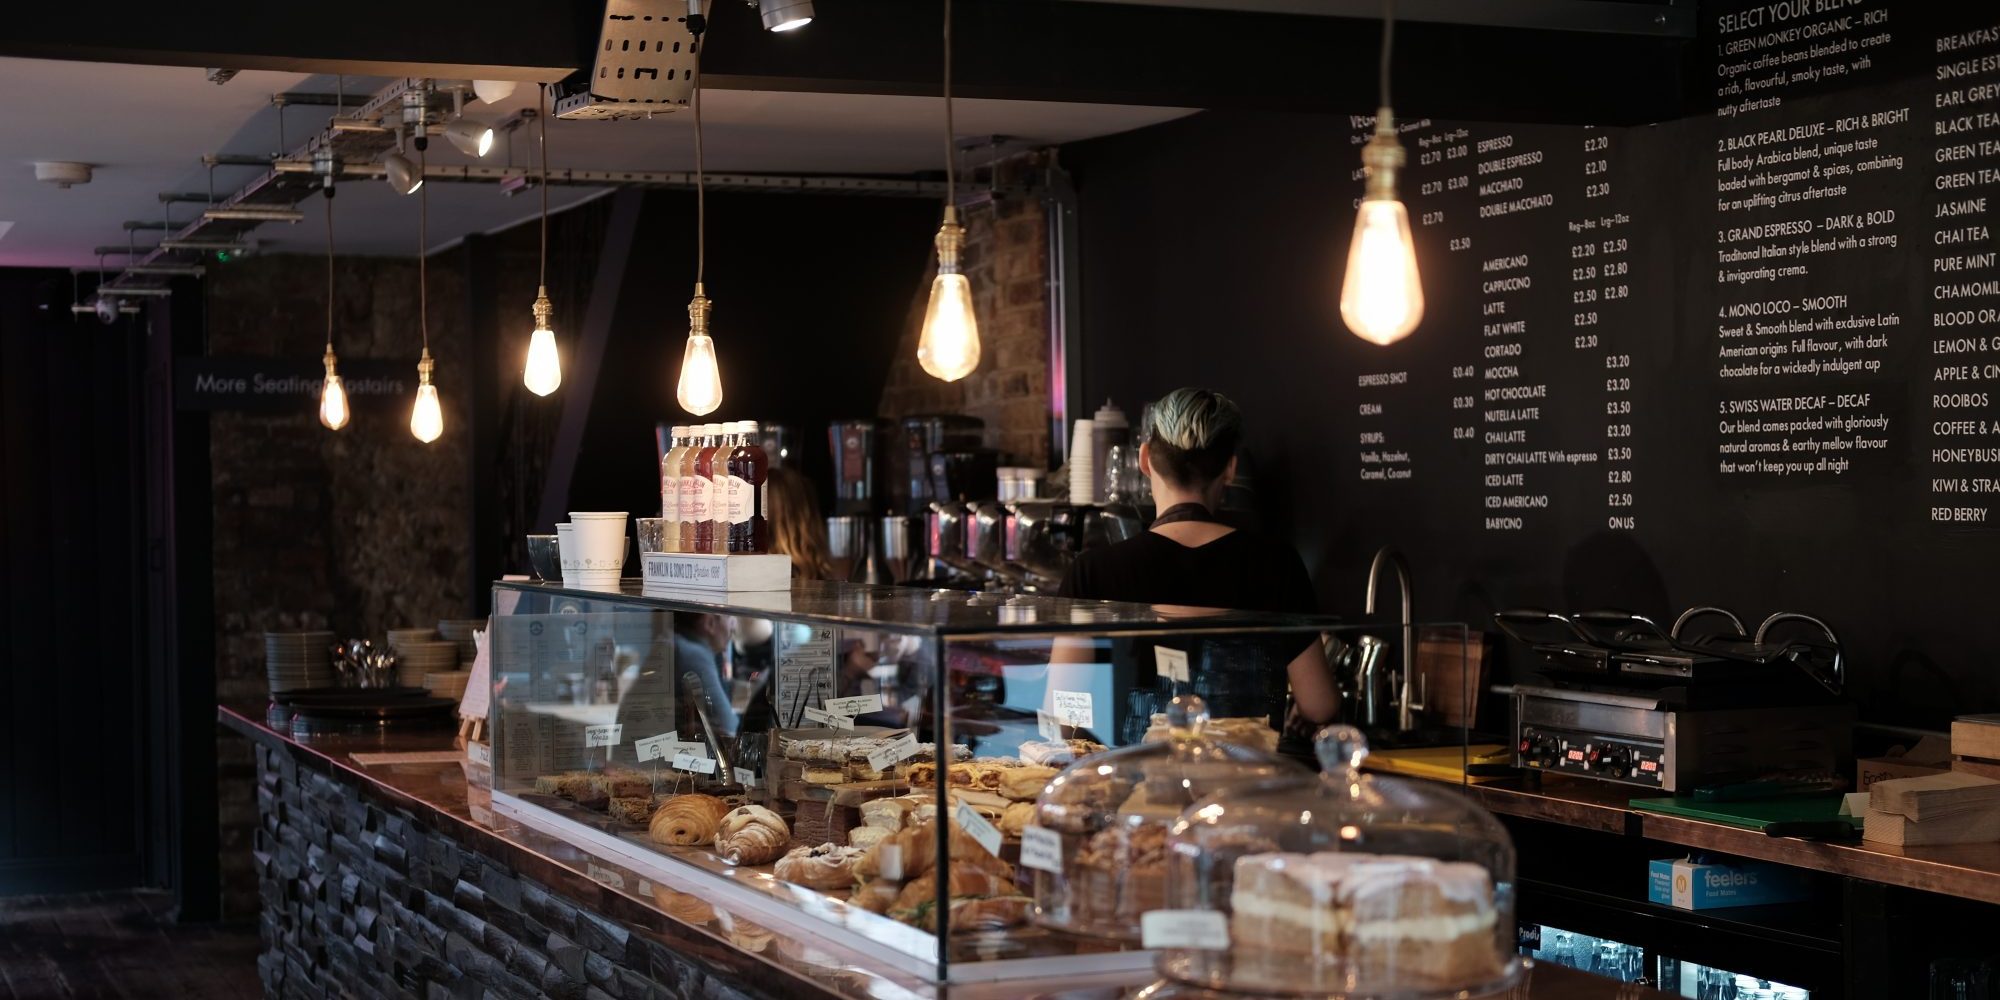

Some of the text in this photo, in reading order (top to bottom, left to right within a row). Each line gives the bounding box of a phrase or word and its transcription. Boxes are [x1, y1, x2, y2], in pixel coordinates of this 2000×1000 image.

[1719, 7, 1765, 34] SELECT
[1769, 0, 1810, 23] YOUR
[1718, 9, 1888, 56] 1. GREEN MONKEY ORGANIC RICH
[1937, 26, 2000, 53] BREAKFAS
[1937, 59, 1978, 80] SINGLE
[1936, 83, 2000, 108] EARL GREY
[1718, 108, 1909, 152] 2. BLACK PEARL DELUXE RICH & BRIGHT
[1936, 112, 2000, 135] BLACK TEA
[1477, 135, 1513, 154] ESPRESSO
[1585, 136, 1608, 151] £2.20
[1421, 145, 1468, 165] £2.70 £3.00
[1936, 140, 2000, 163] GREEN TEA
[1478, 151, 1543, 175] DOUBLE ESPRESSO
[1586, 160, 1607, 174] £2.10
[1422, 176, 1469, 195] £2.70 £3.00
[1479, 177, 1523, 196] MACCHIATO
[1936, 169, 2000, 189] GREEN TEA
[1586, 182, 1609, 197] £2.30
[1480, 194, 1553, 218] DOUBLE MACCHIATO
[1936, 198, 1986, 217] JASMINE
[1423, 211, 1443, 225] £2.70
[1718, 210, 1895, 242] 3. GRAND ESPRESSO DARK & BOLD
[1935, 226, 1989, 244] CHAI TEA
[1450, 237, 1471, 251] £3.50
[1572, 238, 1627, 258] £2.20 £2.50
[1719, 235, 1897, 262] Traditional Italian style blend with a strong
[1483, 255, 1528, 272] AMERICANO
[1934, 253, 1997, 272] PURE MINT
[1573, 262, 1627, 280] £2.50 £2.80
[1719, 265, 1808, 284] & invigorating crema.
[1483, 276, 1530, 293] CAPPUCCINO
[1574, 285, 1628, 303] £2.50 £2.80
[1483, 301, 1505, 315] LATTE
[1719, 295, 1848, 318] 4. MONO LOCO SMOOTH
[1575, 312, 1597, 326] £2.50
[1934, 311, 1974, 326] BLOOD
[1484, 321, 1525, 336] FLAT WHITE
[1575, 335, 1597, 348] £2.30
[1934, 337, 1987, 354] LEMON &
[1485, 343, 1521, 358] CORTADO
[1606, 355, 1629, 368] £3.20
[1453, 365, 1474, 378] £0.40
[1485, 366, 1518, 379] MOCCHA
[1934, 365, 1980, 381] APPLE &
[195, 373, 404, 398] More Seating pstairs
[1359, 372, 1407, 387] ESPRESSO SHOT
[1607, 378, 1630, 391] £3.20
[1485, 385, 1546, 400] HOT CHOCOLATE
[1453, 396, 1474, 409] £0.30
[1607, 401, 1630, 414] £3.50
[1720, 394, 1870, 413] 5. SWISS WATER DECAF DECAF
[1933, 393, 1989, 408] ROOIBOS
[1360, 404, 1382, 415] CREAM
[1485, 408, 1539, 422] NUTELLA LATTE
[1454, 427, 1474, 439] £0.40
[1608, 424, 1631, 437] £3.20
[1933, 421, 1987, 435] COFFEE &
[1485, 430, 1525, 444] CHAI LATTE
[1485, 450, 1597, 465] DIRTY CHAI LATTE With espresso
[1608, 448, 1631, 460] £3.50
[1485, 474, 1523, 486] ICED LATTE
[1608, 470, 1631, 483] £2.80
[1933, 479, 1968, 492] KIWI &
[1486, 496, 1548, 508] ICED AMERICANO
[1609, 494, 1632, 506] £2.50
[1932, 508, 1988, 521] RED BERRY
[1486, 518, 1522, 529] BABYCINO
[1609, 517, 1634, 529] ON US
[648, 562, 669, 576] FRANKLIN
[670, 563, 673, 577] &
[673, 563, 684, 579] SONS
[1705, 870, 1758, 888] feelers
